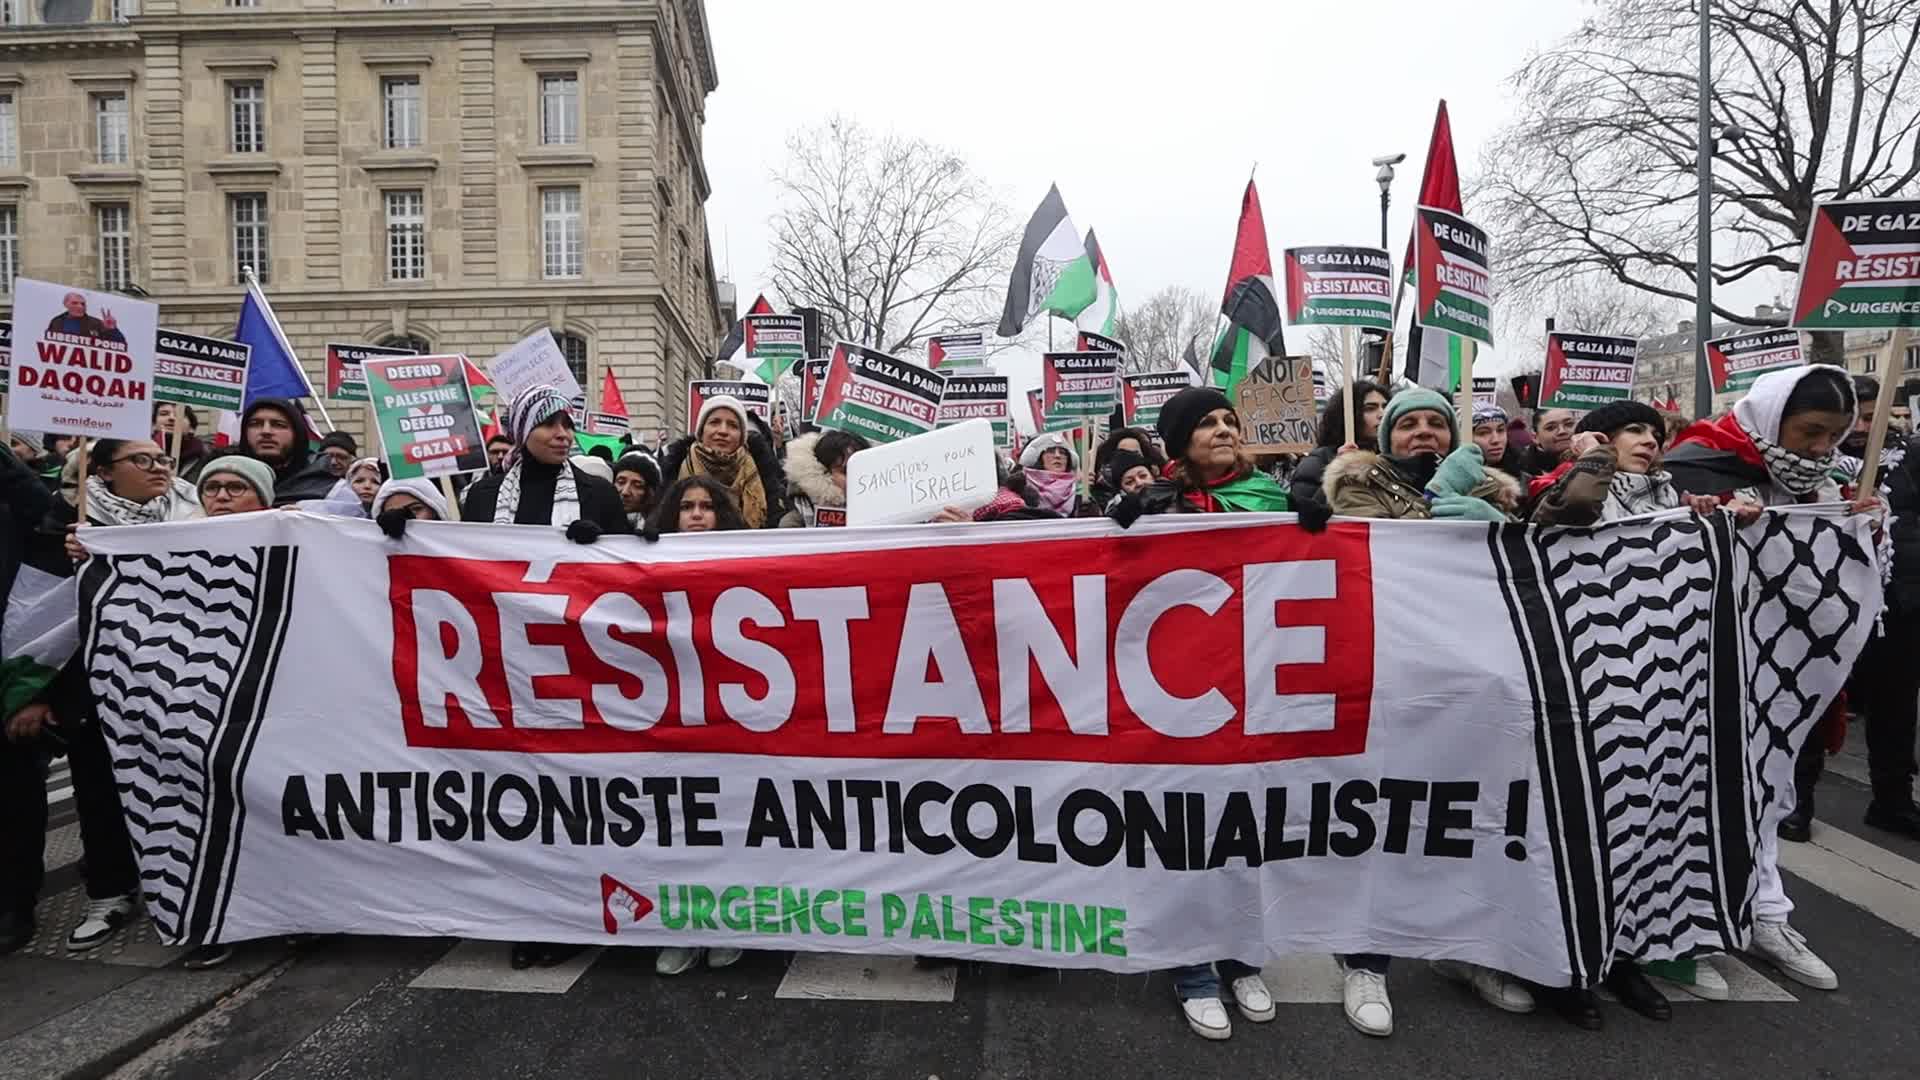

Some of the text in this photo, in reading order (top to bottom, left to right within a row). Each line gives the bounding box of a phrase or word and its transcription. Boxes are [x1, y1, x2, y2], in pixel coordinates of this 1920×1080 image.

[1841, 214, 1920, 233] DE GAZ
[1434, 222, 1450, 240] DE
[1451, 229, 1476, 251] GAZA
[1300, 254, 1389, 269] DE GAZA A PARIS
[1836, 255, 1920, 280] RÉSIST
[95, 340, 127, 351] POUR
[160, 338, 246, 361] GAZA A PARIS
[1562, 341, 1575, 352] DE
[1577, 342, 1604, 354] GAZA
[1606, 344, 1614, 355] A
[1720, 342, 1732, 352] DE
[1734, 337, 1762, 349] GAZA
[1764, 336, 1771, 345] A
[37, 342, 133, 374] WALID
[338, 350, 350, 359] DE
[1054, 359, 1066, 368] DE
[1067, 358, 1093, 368] GAZA
[1094, 358, 1101, 368] A
[1794, 350, 1799, 359] !
[236, 371, 241, 383] !
[386, 364, 442, 380] DEFEND
[848, 352, 943, 397] DE GAZA A PARIS
[1252, 356, 1302, 384] NOT
[1626, 370, 1631, 382] !
[18, 366, 145, 401] DAQQAH
[700, 387, 710, 396] DE
[711, 387, 736, 396] GAZA
[737, 388, 745, 396] A
[944, 382, 1007, 393] AZA A PARIS
[1131, 380, 1140, 388] DE
[1140, 378, 1163, 387] GAZA
[1164, 378, 1170, 386] A
[384, 388, 458, 409] PALESTINE
[1240, 384, 1310, 408] PEACE
[929, 410, 935, 422] !
[1000, 404, 1005, 416] !
[400, 415, 455, 432] DEFEND
[847, 414, 888, 435] URGENCE
[411, 438, 463, 459] GAZA !
[910, 472, 977, 505] ISRAEL
[819, 511, 847, 524] GAZ
[411, 560, 1336, 738] RÉSISTANCE
[282, 771, 1530, 870] ANTISIONISTE ANTICOLONIALISTE !
[658, 883, 1128, 957] URGENCE PALESTINE
